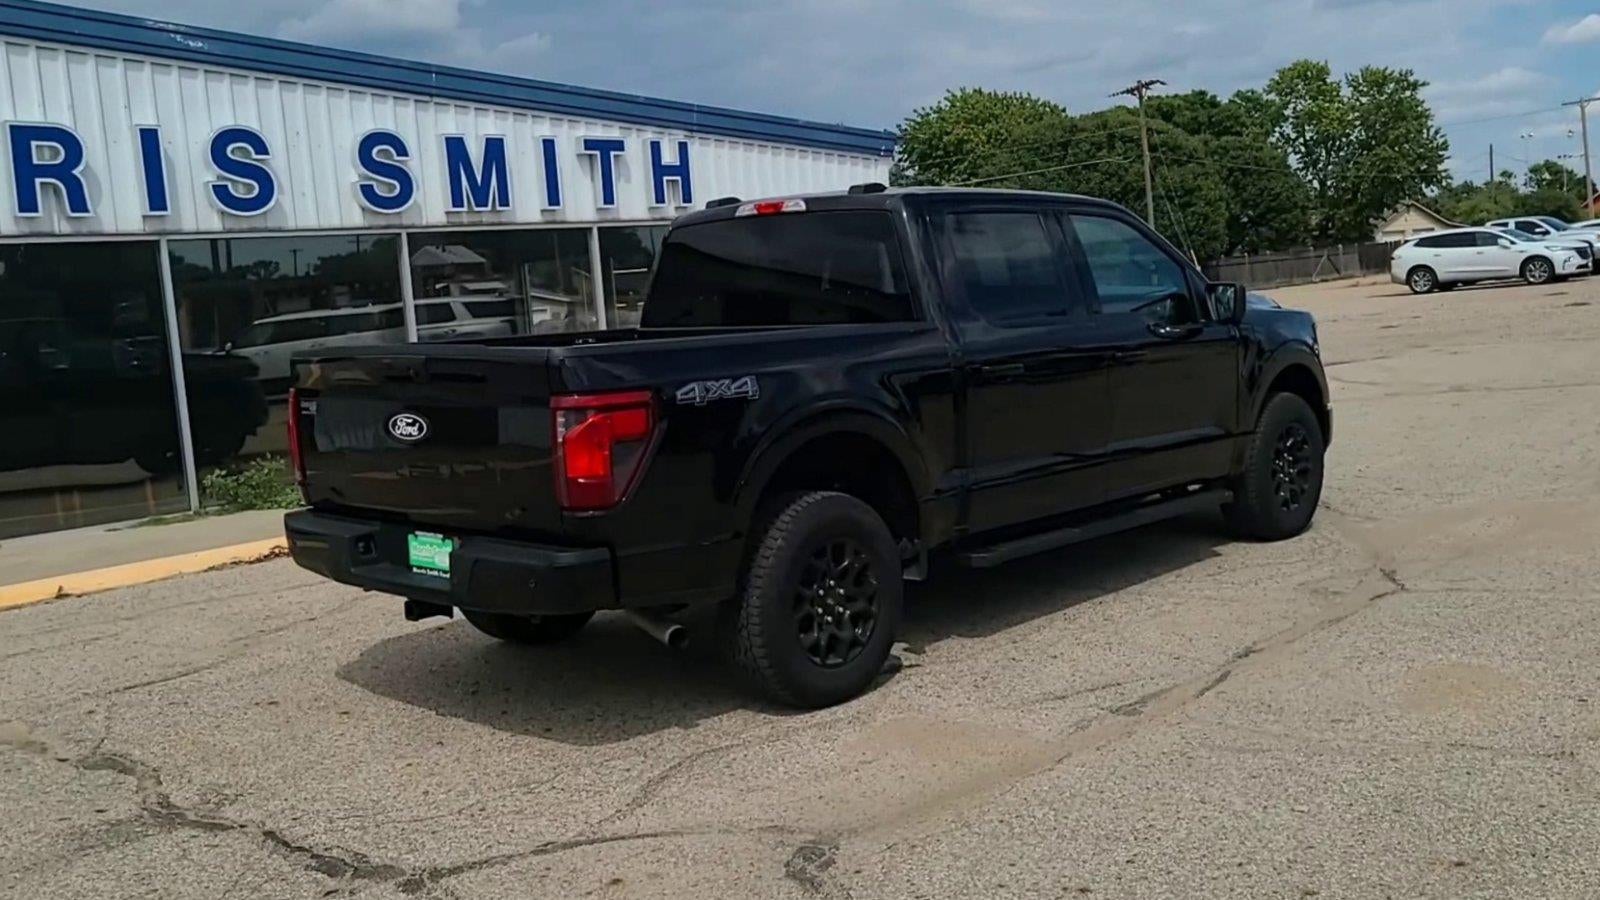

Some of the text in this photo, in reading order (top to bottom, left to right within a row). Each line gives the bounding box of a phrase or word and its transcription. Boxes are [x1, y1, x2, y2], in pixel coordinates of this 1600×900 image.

[5, 121, 695, 218] RIS SMITH
[393, 416, 421, 437] Ford
